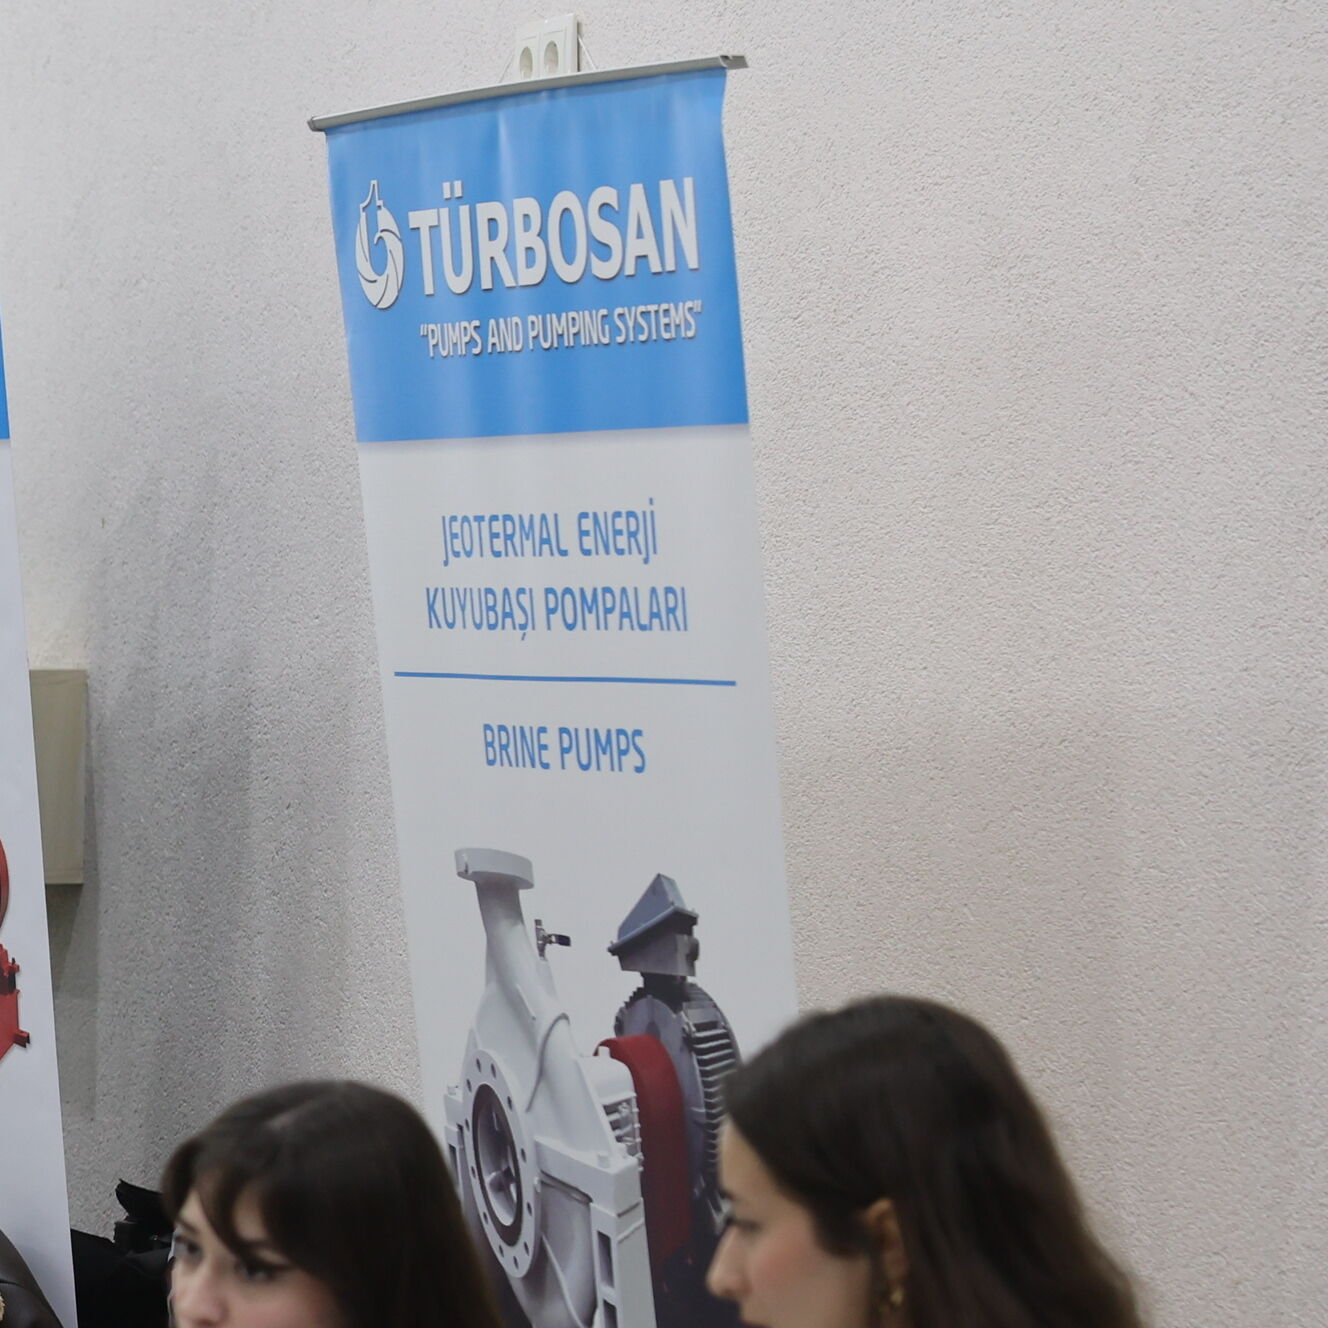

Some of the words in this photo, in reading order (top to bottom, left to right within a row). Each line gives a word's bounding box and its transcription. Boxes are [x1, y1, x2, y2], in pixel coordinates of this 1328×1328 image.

[408, 177, 701, 296] TÜRBOSAN
[487, 315, 524, 354] AND
[528, 308, 611, 351] PUMPING
[441, 512, 570, 568] JEOTERMAL
[576, 496, 659, 566] ENERJİ
[425, 585, 537, 642] KUYUBAŞI
[543, 585, 689, 632] POMPALARI
[483, 723, 549, 769] BRINE
[558, 725, 647, 774] PUMPS
